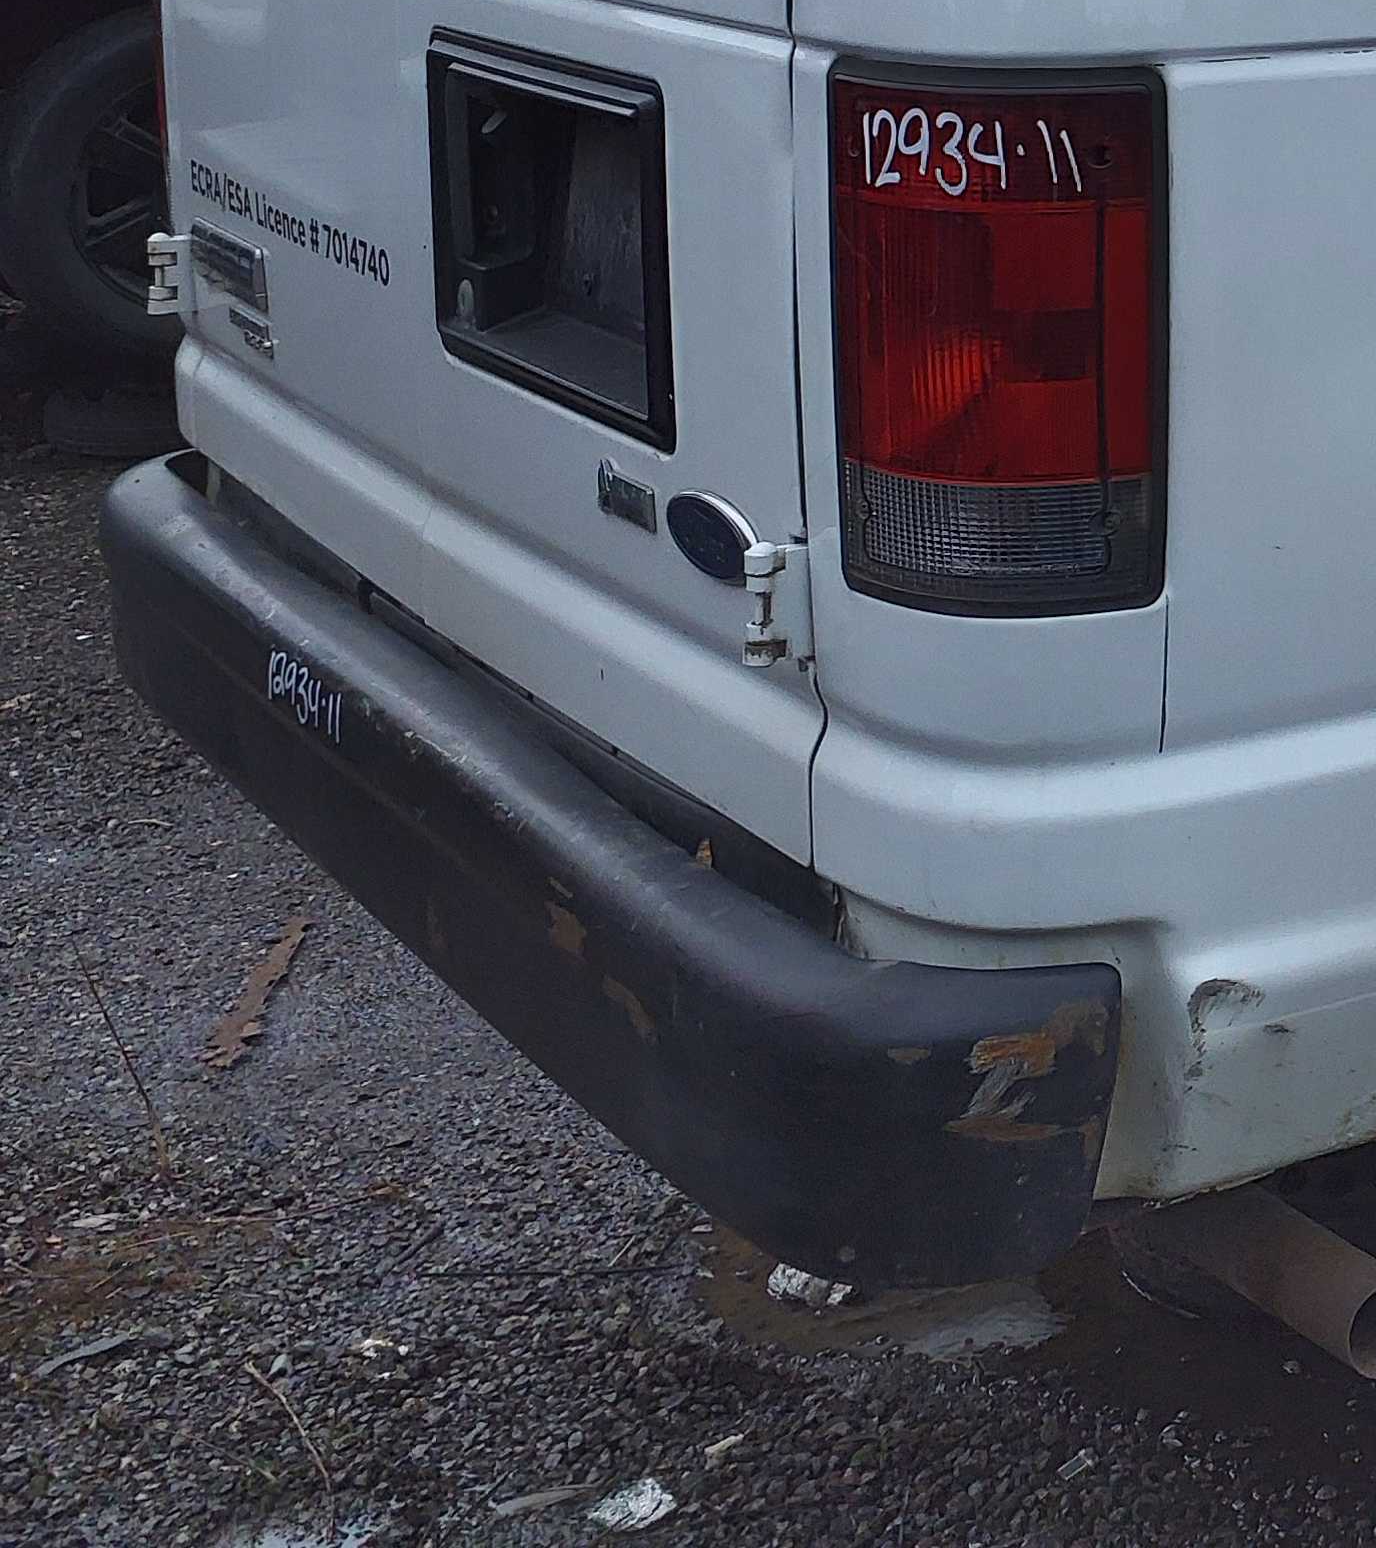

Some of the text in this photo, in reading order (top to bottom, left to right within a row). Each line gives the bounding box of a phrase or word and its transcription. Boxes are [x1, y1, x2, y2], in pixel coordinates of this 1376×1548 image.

[191, 159, 253, 222] ECRA/ESA
[254, 192, 307, 248] Licence
[322, 224, 391, 287] 7014740
